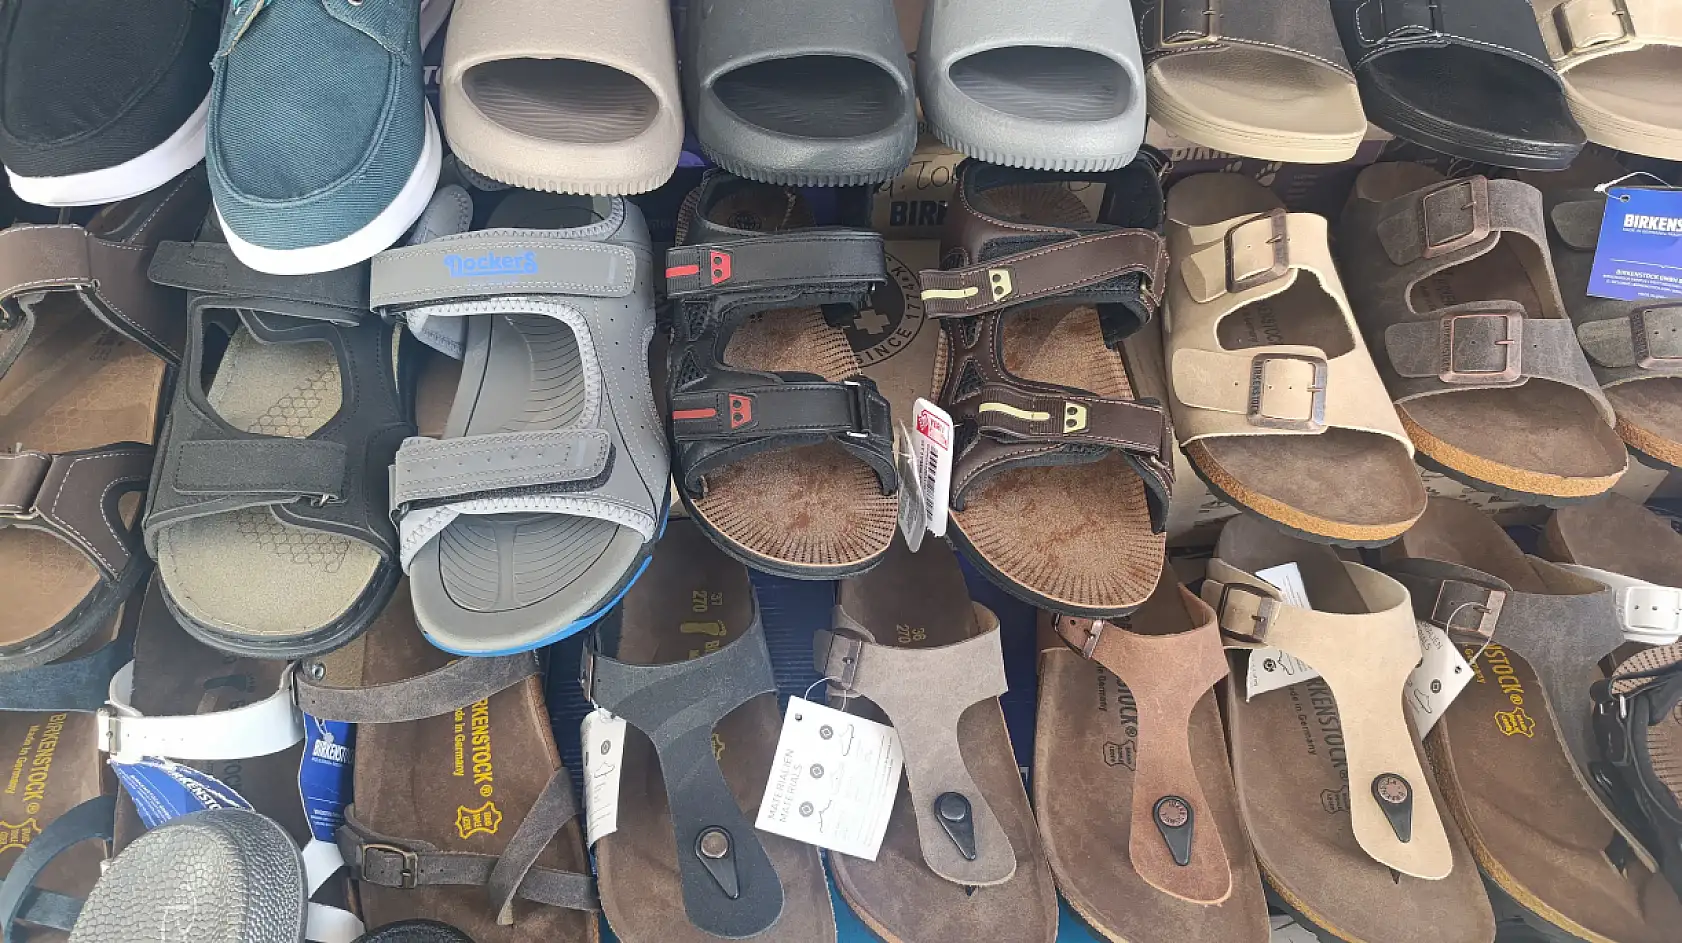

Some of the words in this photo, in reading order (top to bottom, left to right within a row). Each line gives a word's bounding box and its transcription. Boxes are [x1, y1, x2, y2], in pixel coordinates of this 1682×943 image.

[1623, 213, 1682, 232] BIRKENS
[692, 590, 708, 613] 270
[896, 624, 911, 643] 270
[453, 733, 466, 776] Germany
[1298, 714, 1317, 756] Germany
[768, 748, 794, 820] MATERIALIEN
[779, 764, 803, 823] MATERIALS
